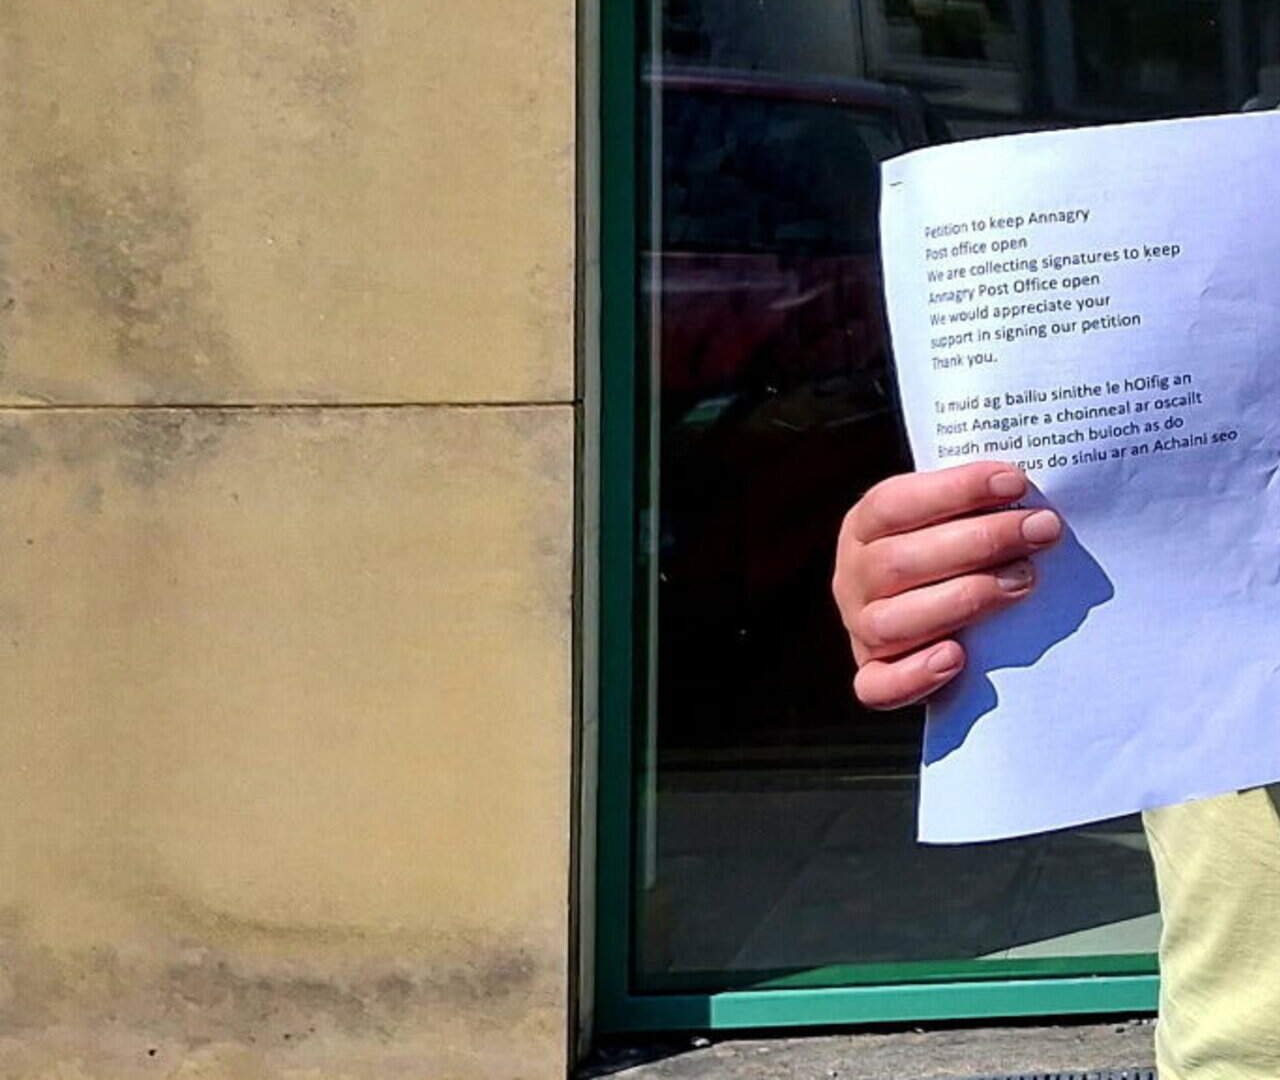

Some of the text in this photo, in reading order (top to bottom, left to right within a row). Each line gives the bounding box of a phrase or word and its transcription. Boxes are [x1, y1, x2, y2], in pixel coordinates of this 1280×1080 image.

[925, 209, 1091, 239] Petition to keep Annagry
[927, 243, 1181, 283] We are collecting signatures to keep
[951, 241, 987, 257] office
[991, 237, 1028, 253] open
[978, 282, 1010, 297] Post
[1013, 276, 1059, 294] Office
[1062, 274, 1101, 291] open
[930, 295, 1111, 327] We would appreciate your
[977, 328, 991, 342] in
[994, 323, 1048, 342] signing
[1051, 321, 1077, 335] our
[1081, 313, 1142, 334] petition
[932, 352, 998, 370] Thank you.
[947, 395, 980, 412] muid
[983, 396, 1002, 411] ag
[1105, 381, 1121, 395] le
[1124, 374, 1170, 392] hOifig
[1173, 372, 1192, 386] an
[972, 413, 1039, 432] Anagaire
[1043, 413, 1053, 425] a
[1056, 400, 1130, 423] choinneal
[1135, 400, 1151, 414] ar
[1154, 391, 1203, 410] oscailt
[983, 436, 1023, 453] muid
[1027, 428, 1084, 448] iontach
[1143, 420, 1160, 433] as
[1163, 415, 1184, 431] do
[1012, 458, 1043, 472] gus
[1047, 453, 1068, 468] do
[1111, 446, 1127, 459] ar
[1130, 442, 1149, 457] an
[1211, 429, 1239, 444] seo
